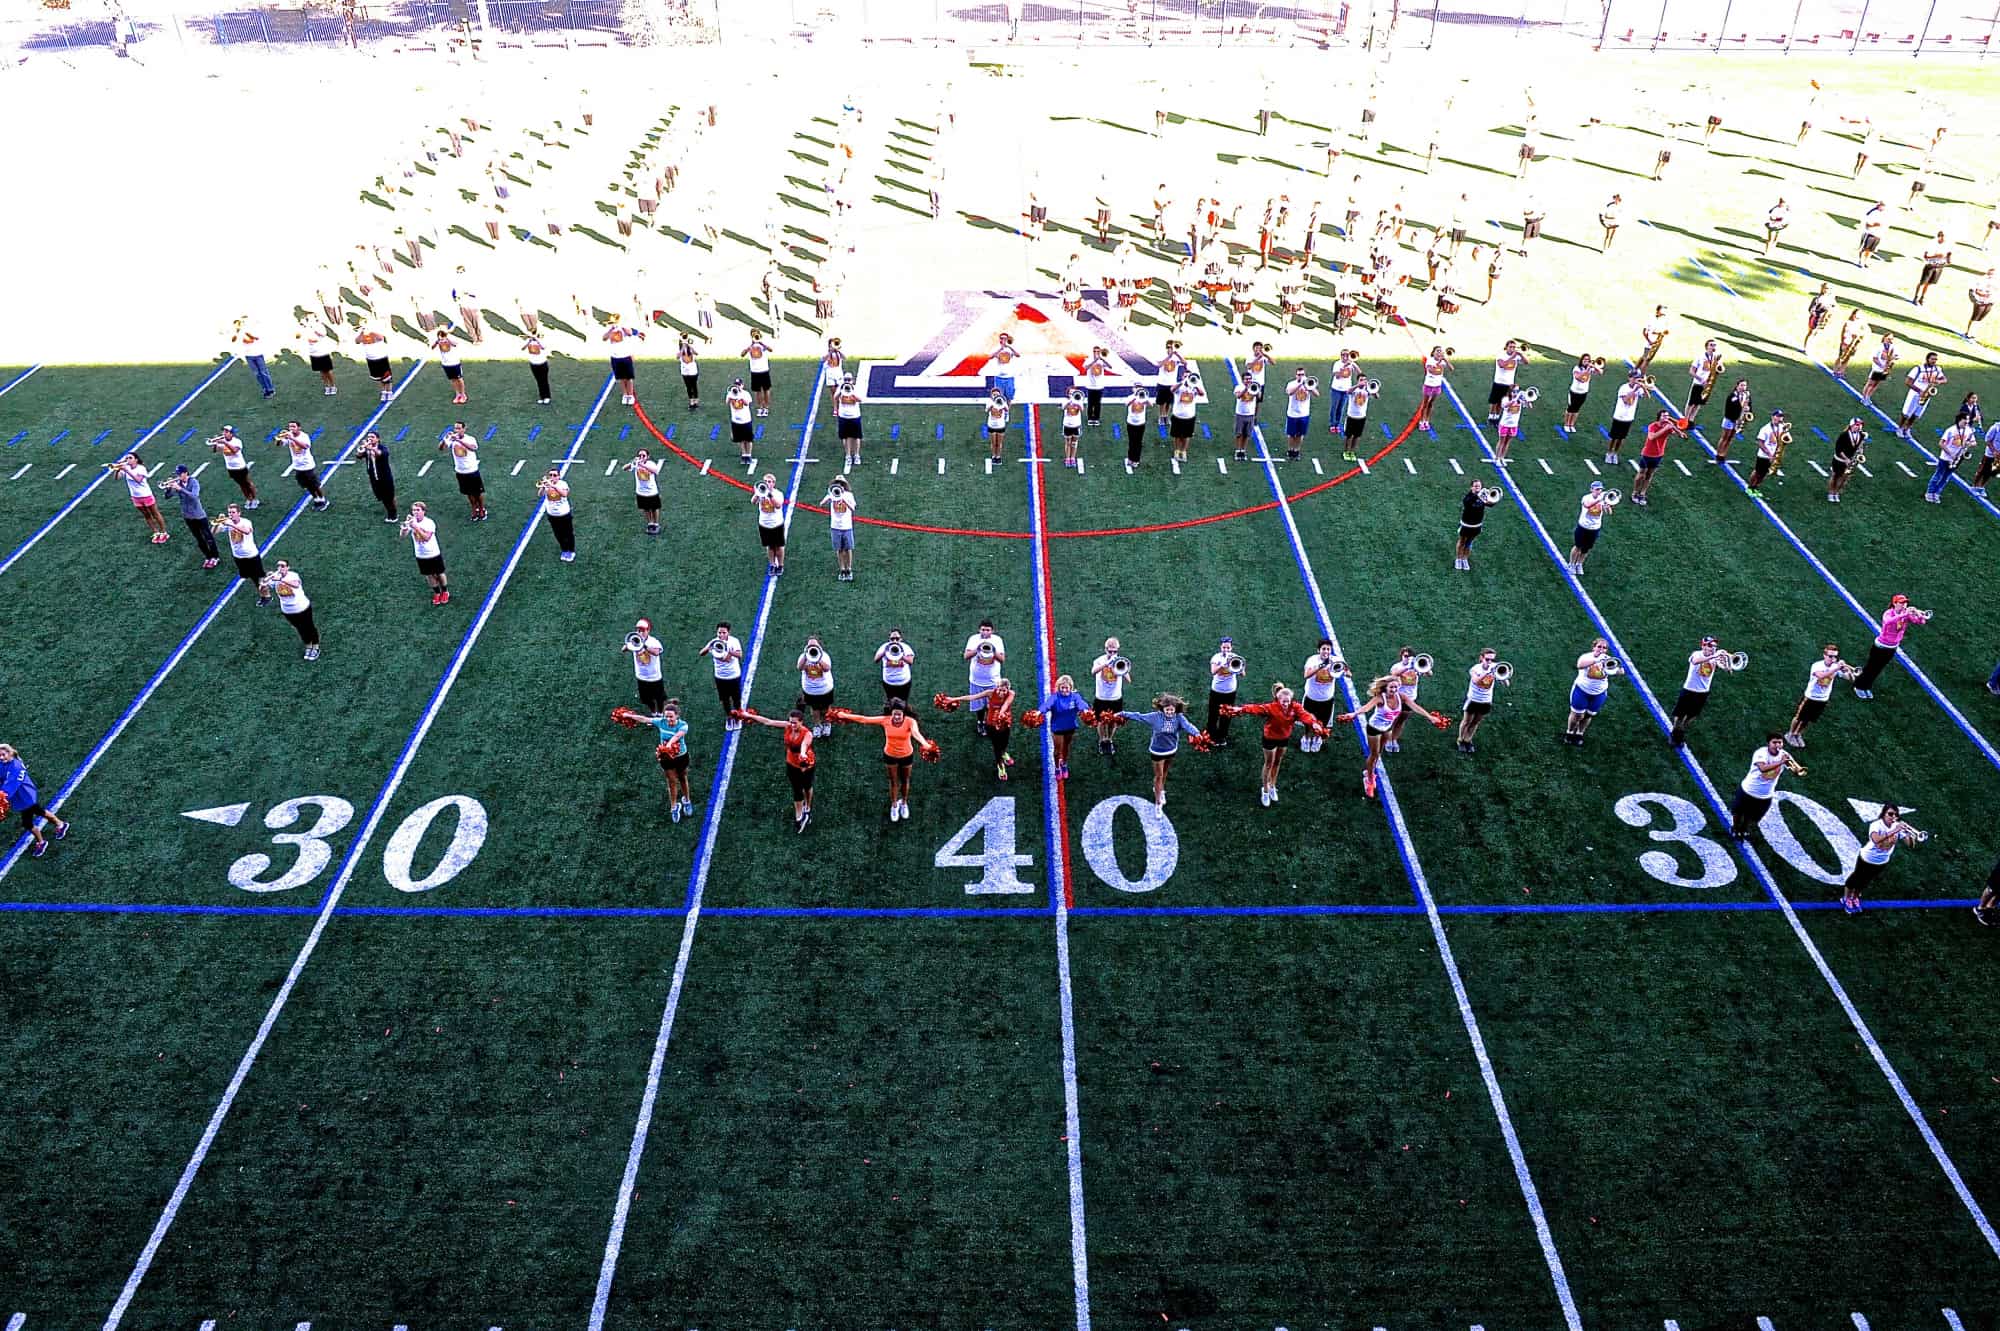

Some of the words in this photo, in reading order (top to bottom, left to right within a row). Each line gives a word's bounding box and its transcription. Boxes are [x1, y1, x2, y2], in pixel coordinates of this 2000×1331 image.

[860, 290, 1206, 402] A
[227, 795, 488, 892] 30
[934, 795, 1179, 894] 40
[1614, 791, 1863, 888] 30
